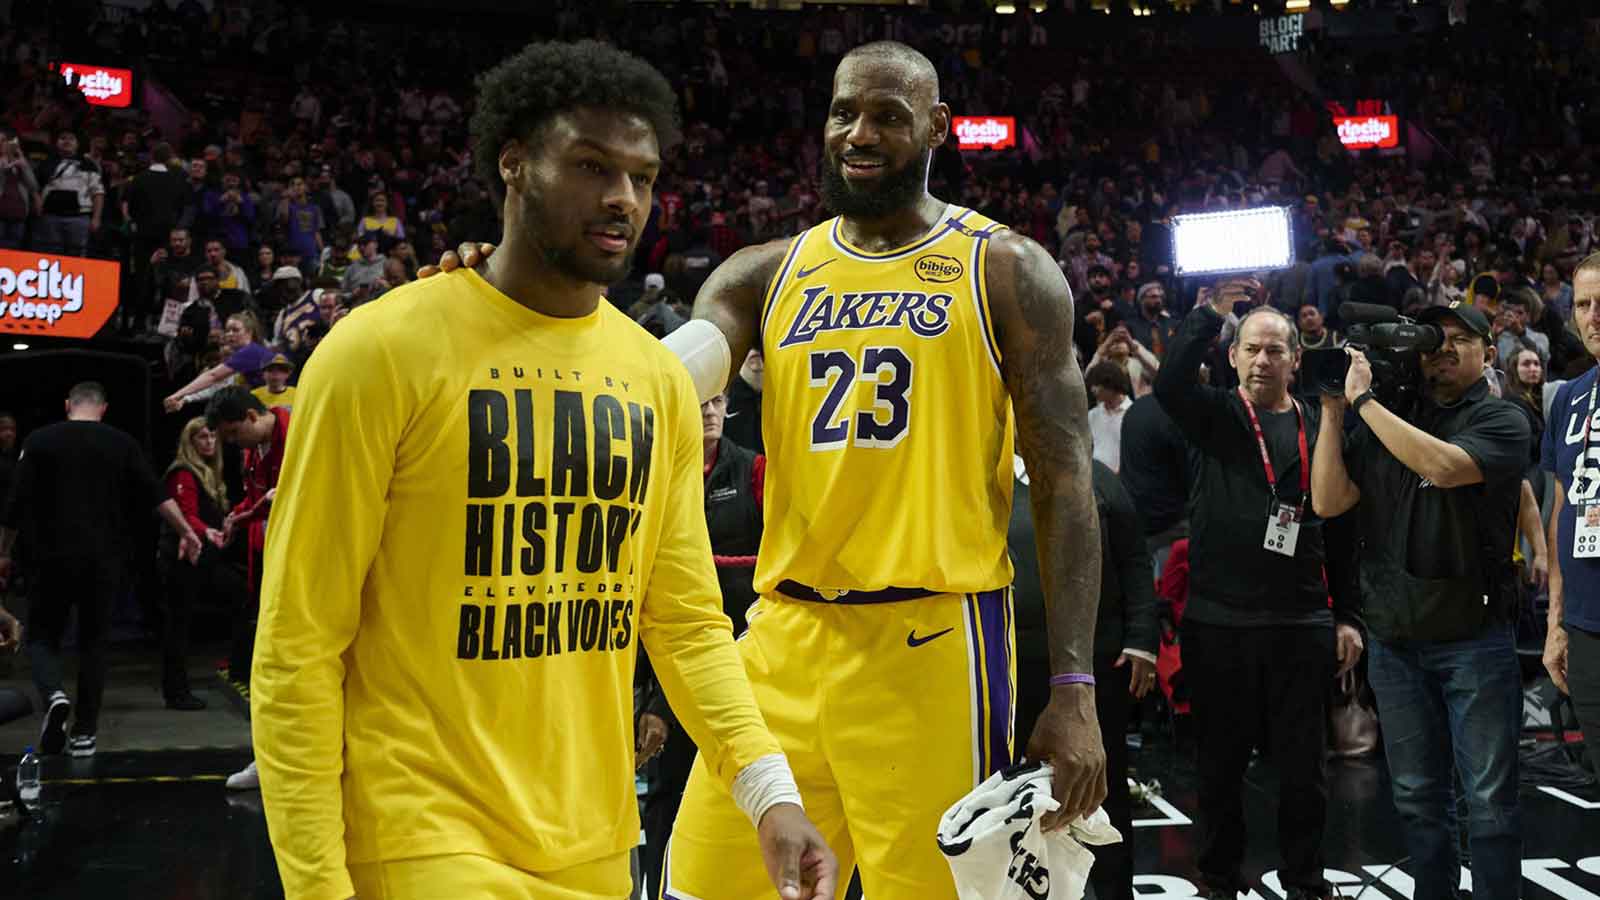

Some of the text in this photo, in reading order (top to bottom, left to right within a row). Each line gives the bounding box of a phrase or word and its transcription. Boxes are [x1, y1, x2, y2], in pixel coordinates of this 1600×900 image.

[1260, 32, 1303, 54] PART
[919, 260, 961, 275] bibigo
[9, 296, 62, 325] deep
[777, 285, 953, 349] LAKERS
[490, 367, 630, 392] BUILT BY
[808, 346, 912, 451] 23
[467, 388, 654, 505] BLACK
[464, 582, 607, 598] ELEVATED
[456, 601, 562, 660] BLACK
